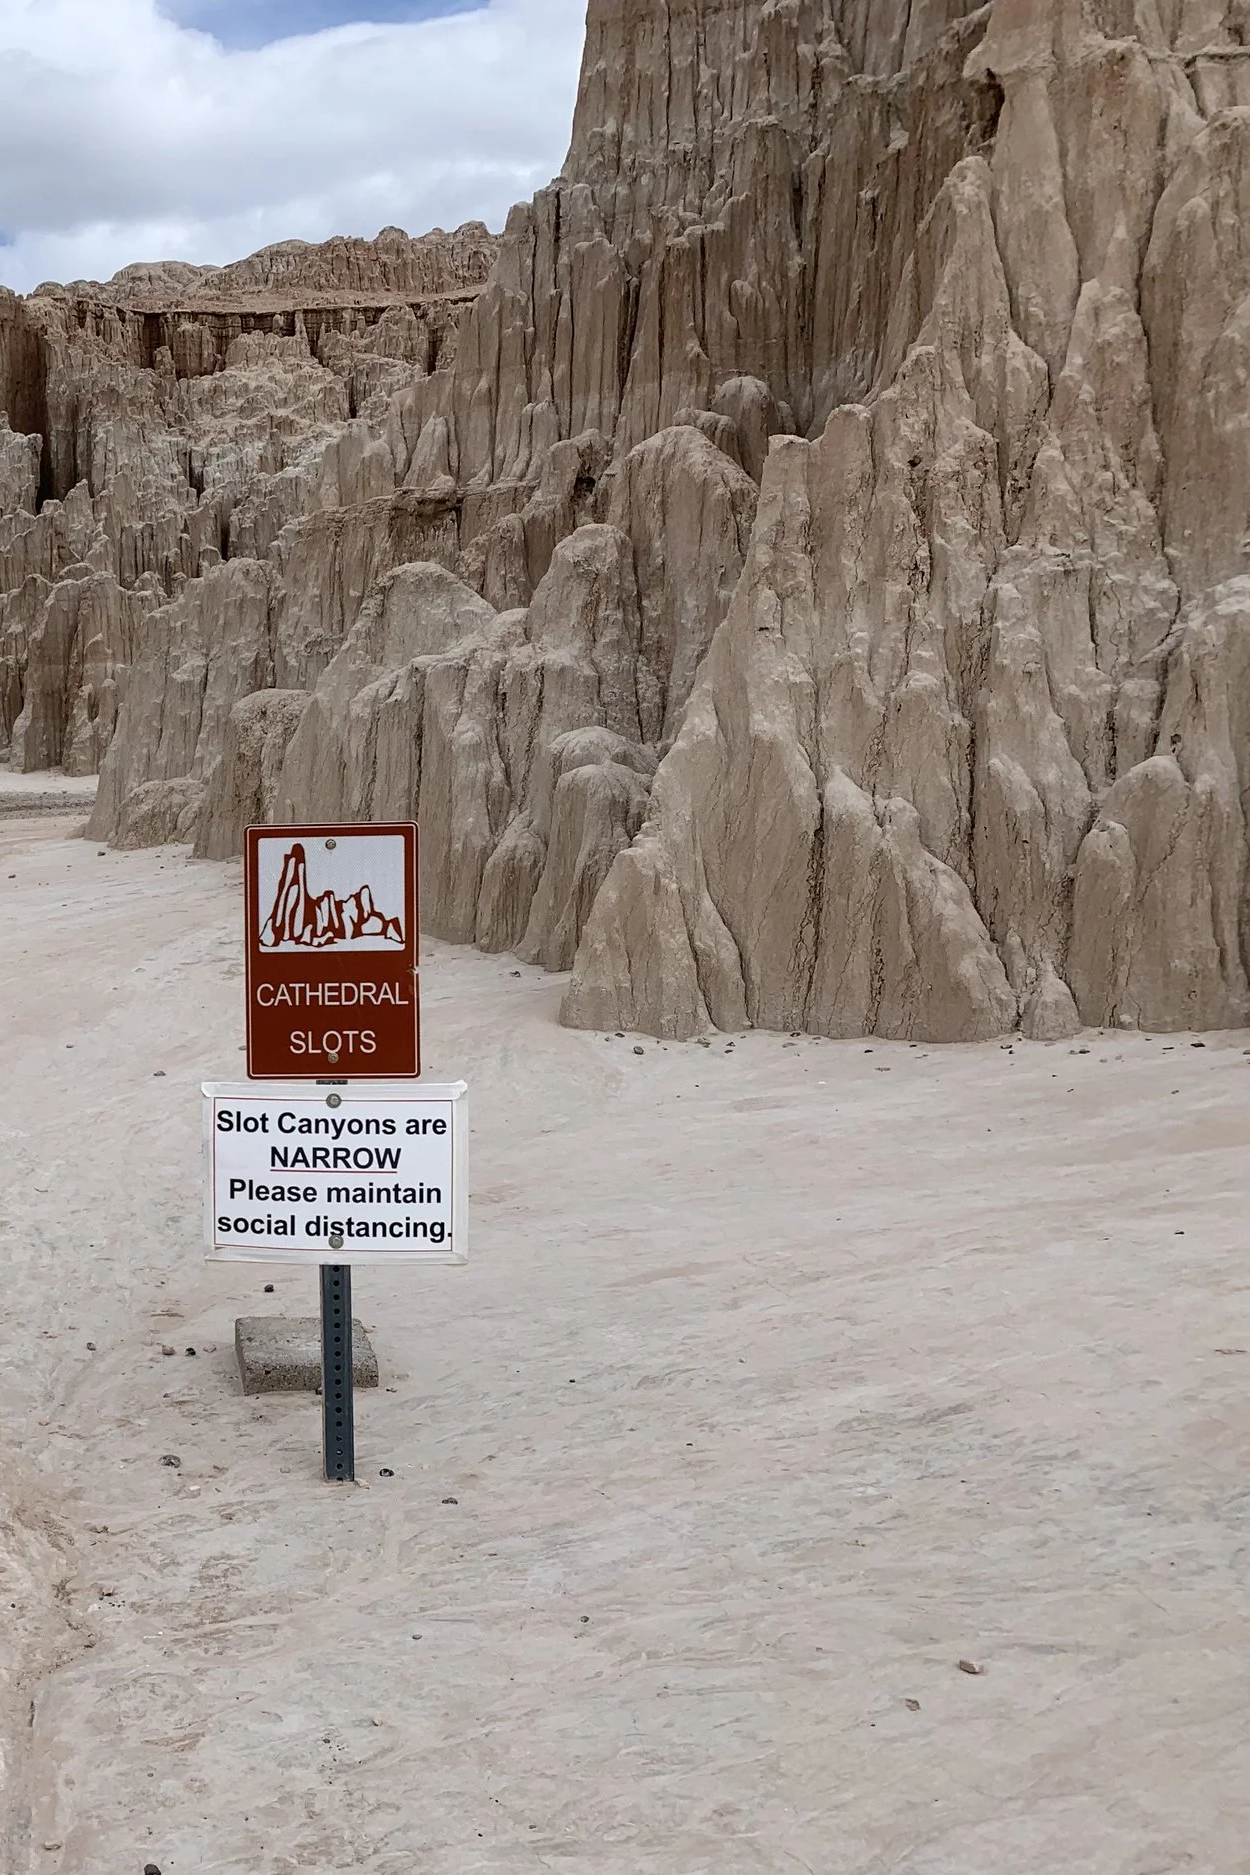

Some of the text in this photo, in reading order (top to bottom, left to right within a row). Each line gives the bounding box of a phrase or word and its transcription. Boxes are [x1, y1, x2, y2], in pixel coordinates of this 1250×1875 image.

[256, 982, 409, 1007] CATHEDRAL
[289, 1030, 377, 1054] SLOTS
[216, 1110, 447, 1140] Slot Canyons are
[270, 1146, 401, 1169] NARROW
[229, 1178, 442, 1204] Please maintain
[217, 1214, 452, 1243] social distancing.
